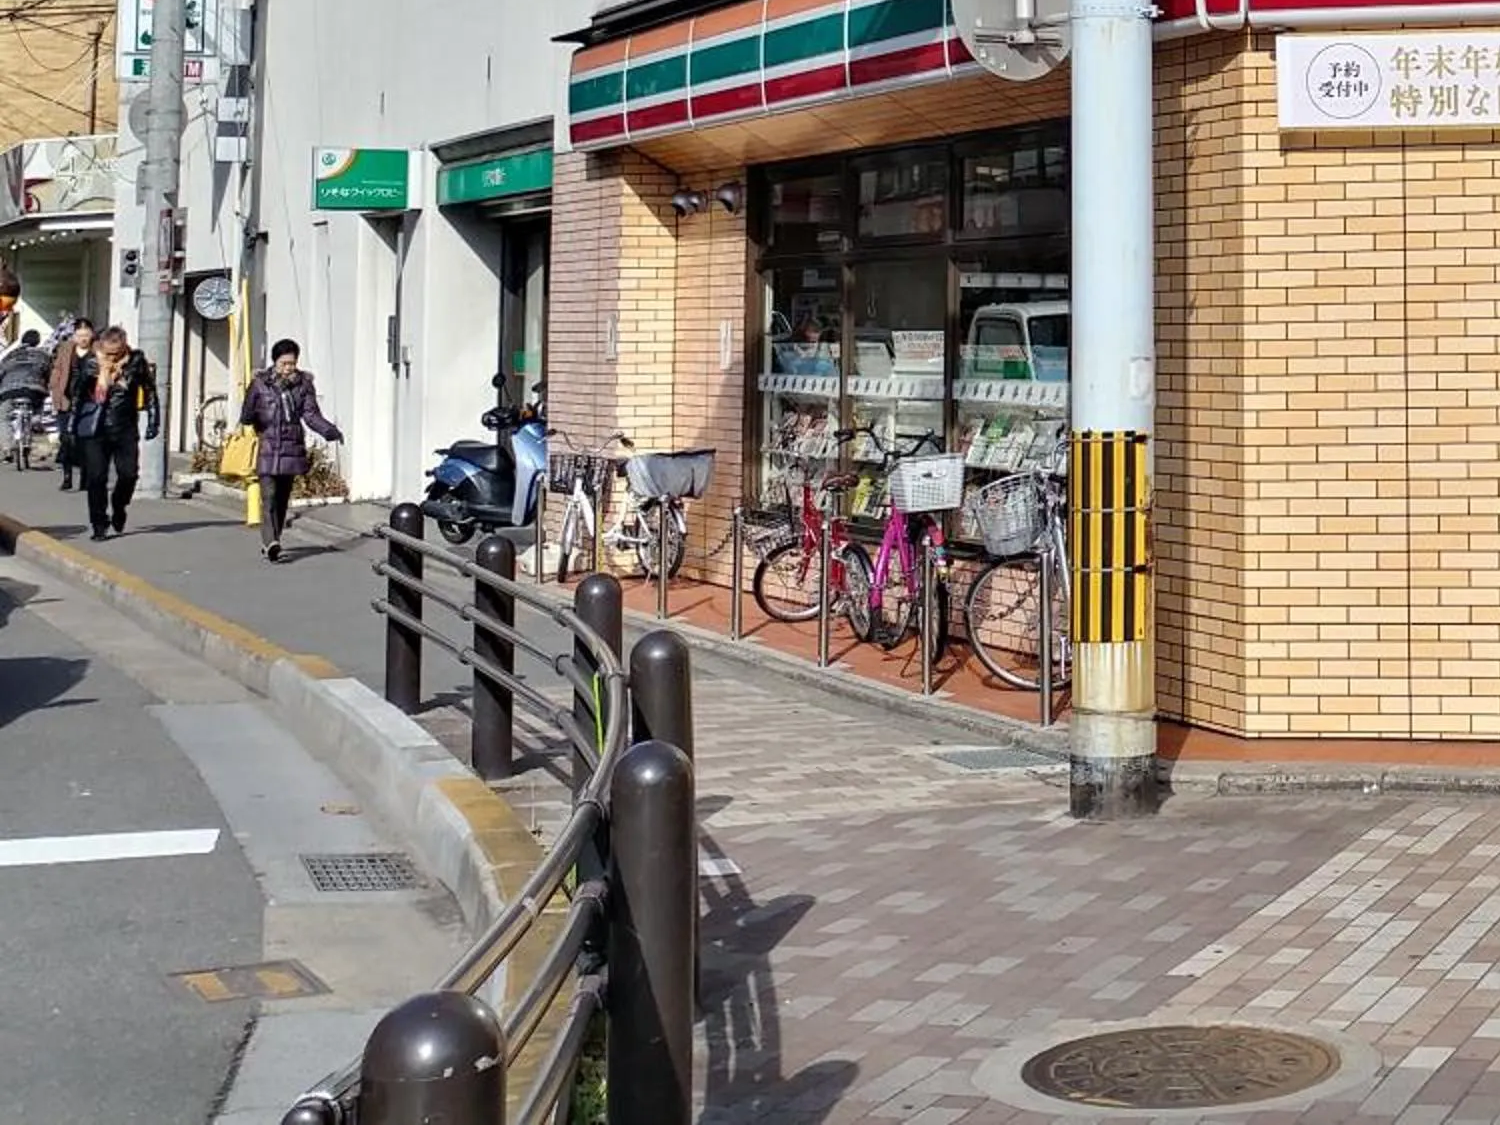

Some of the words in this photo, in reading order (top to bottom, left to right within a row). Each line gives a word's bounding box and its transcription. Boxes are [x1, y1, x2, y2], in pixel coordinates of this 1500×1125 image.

[1328, 61, 1361, 79] 予約
[1318, 80, 1369, 99] 受付中
